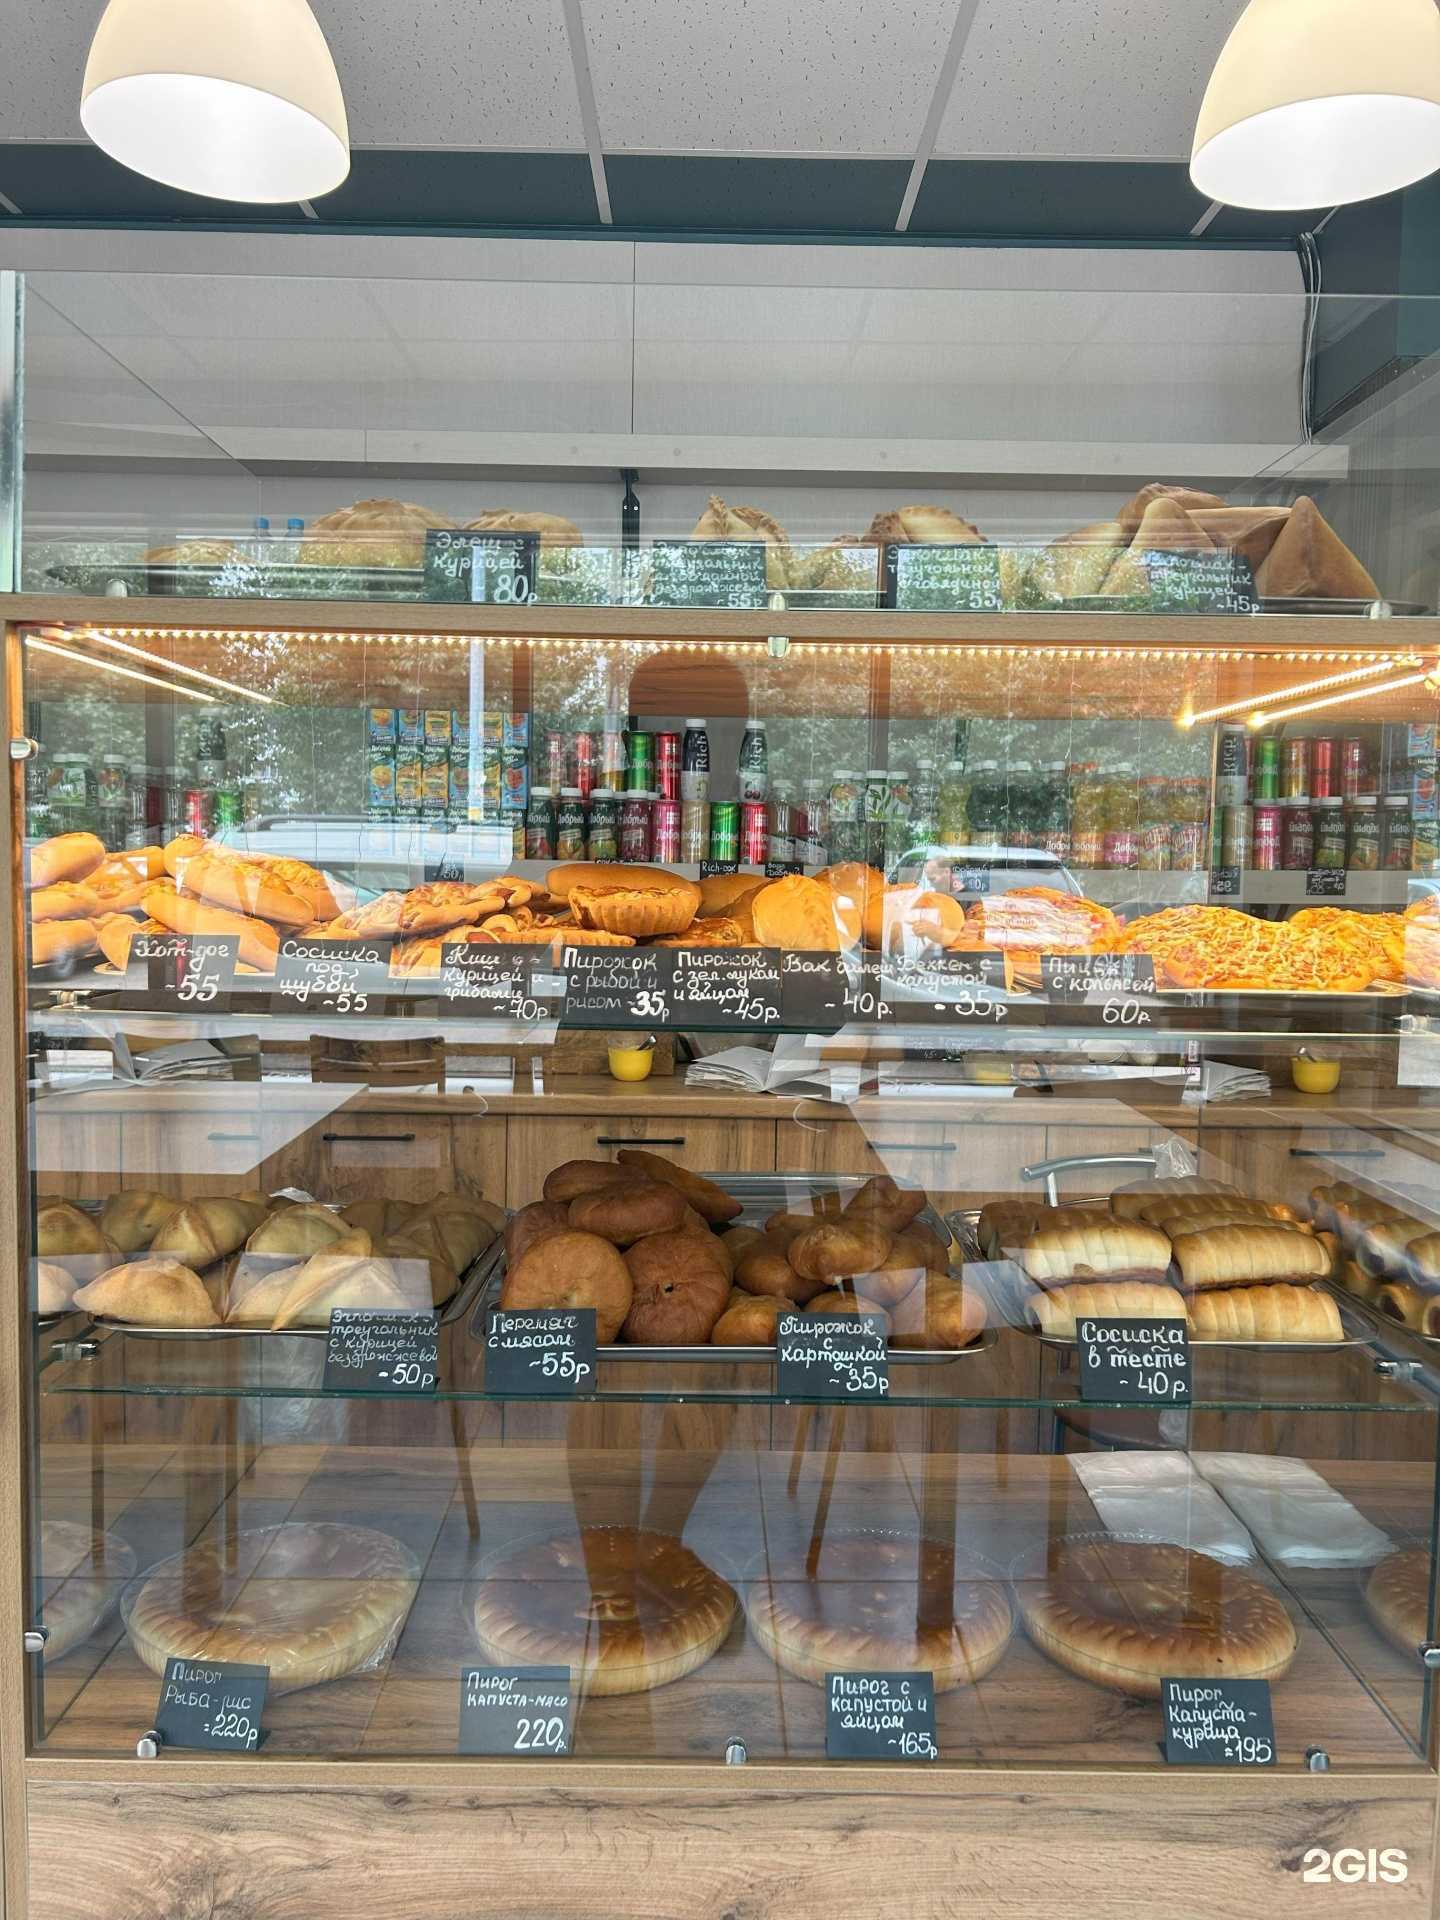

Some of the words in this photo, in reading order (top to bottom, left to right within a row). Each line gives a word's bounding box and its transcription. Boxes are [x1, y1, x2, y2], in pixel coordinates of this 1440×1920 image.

[433, 551, 524, 577] курицей
[888, 562, 994, 580] тугольник
[696, 735, 707, 768] Rich
[282, 940, 384, 964] Сосиска
[563, 947, 658, 975] Пирожок
[678, 951, 768, 968] Пирожок
[443, 967, 525, 987] курицей
[571, 974, 580, 987] с
[586, 968, 641, 993] рыбой
[647, 975, 658, 990] и
[673, 970, 683, 983] с
[897, 971, 988, 996] капустой
[674, 989, 684, 1000] и
[688, 981, 750, 1004] яйцом
[566, 996, 622, 1014] рисом
[331, 1321, 438, 1340] треугольник
[780, 1315, 876, 1339] Пирожок
[1081, 1321, 1184, 1345] Сосиска
[329, 1338, 340, 1348] с
[345, 1336, 418, 1354] курицей
[488, 1336, 498, 1348] с
[501, 1334, 575, 1349] мясом
[781, 1337, 886, 1369] картошкой
[823, 1337, 833, 1350] с
[1088, 1344, 1101, 1368] в
[1106, 1345, 1186, 1369] тесте
[467, 1671, 518, 1691] Пирог
[832, 1675, 890, 1695] Пирог
[900, 1681, 910, 1695] с
[831, 1695, 914, 1713] капустой
[917, 1698, 927, 1712] и
[1169, 1683, 1222, 1709] Пирог
[840, 1712, 904, 1734] яйцом
[514, 1717, 567, 1753] 220р.
[1172, 1725, 1241, 1749] курица
